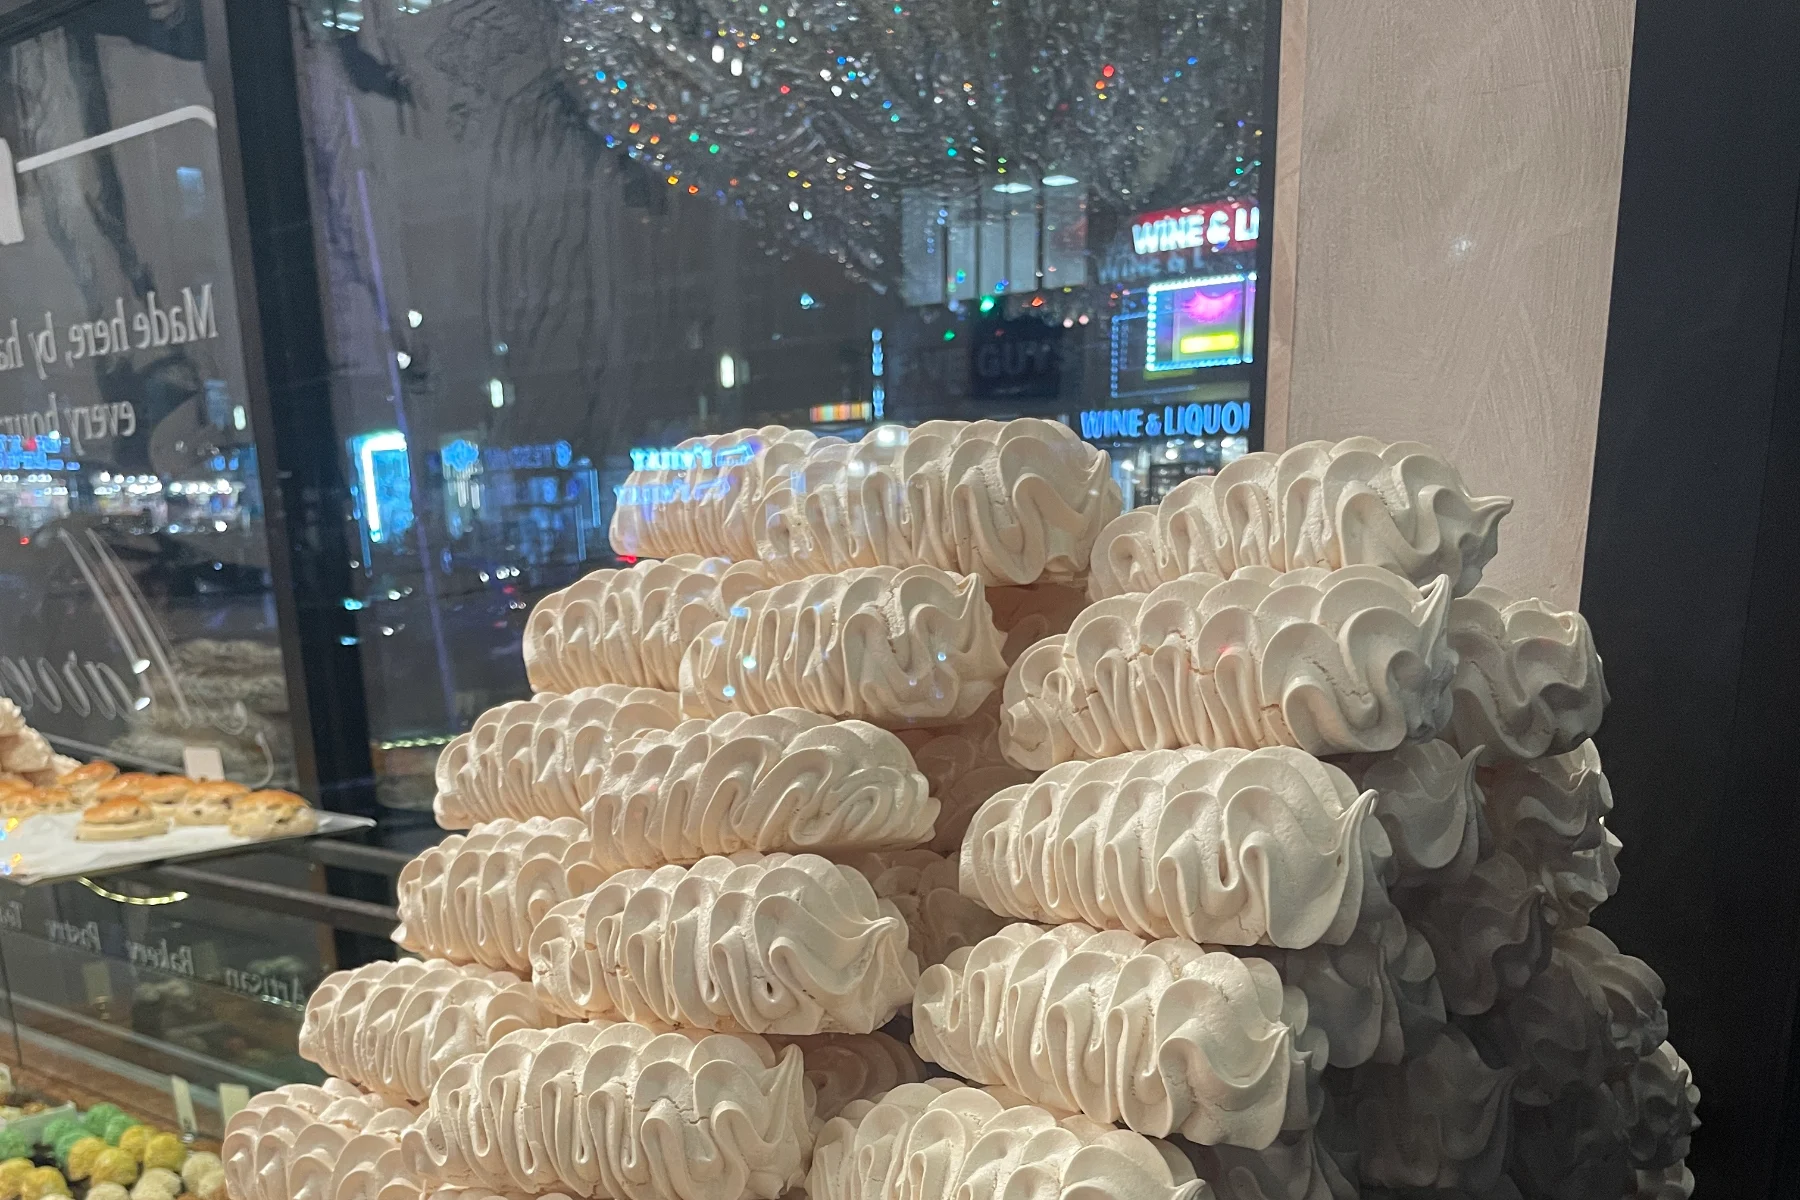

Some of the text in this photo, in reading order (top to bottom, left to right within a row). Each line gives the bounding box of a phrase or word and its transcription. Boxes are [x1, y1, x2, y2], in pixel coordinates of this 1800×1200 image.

[1132, 215, 1205, 255] WINE
[1080, 409, 1144, 439] WINE
[1146, 414, 1161, 436] &
